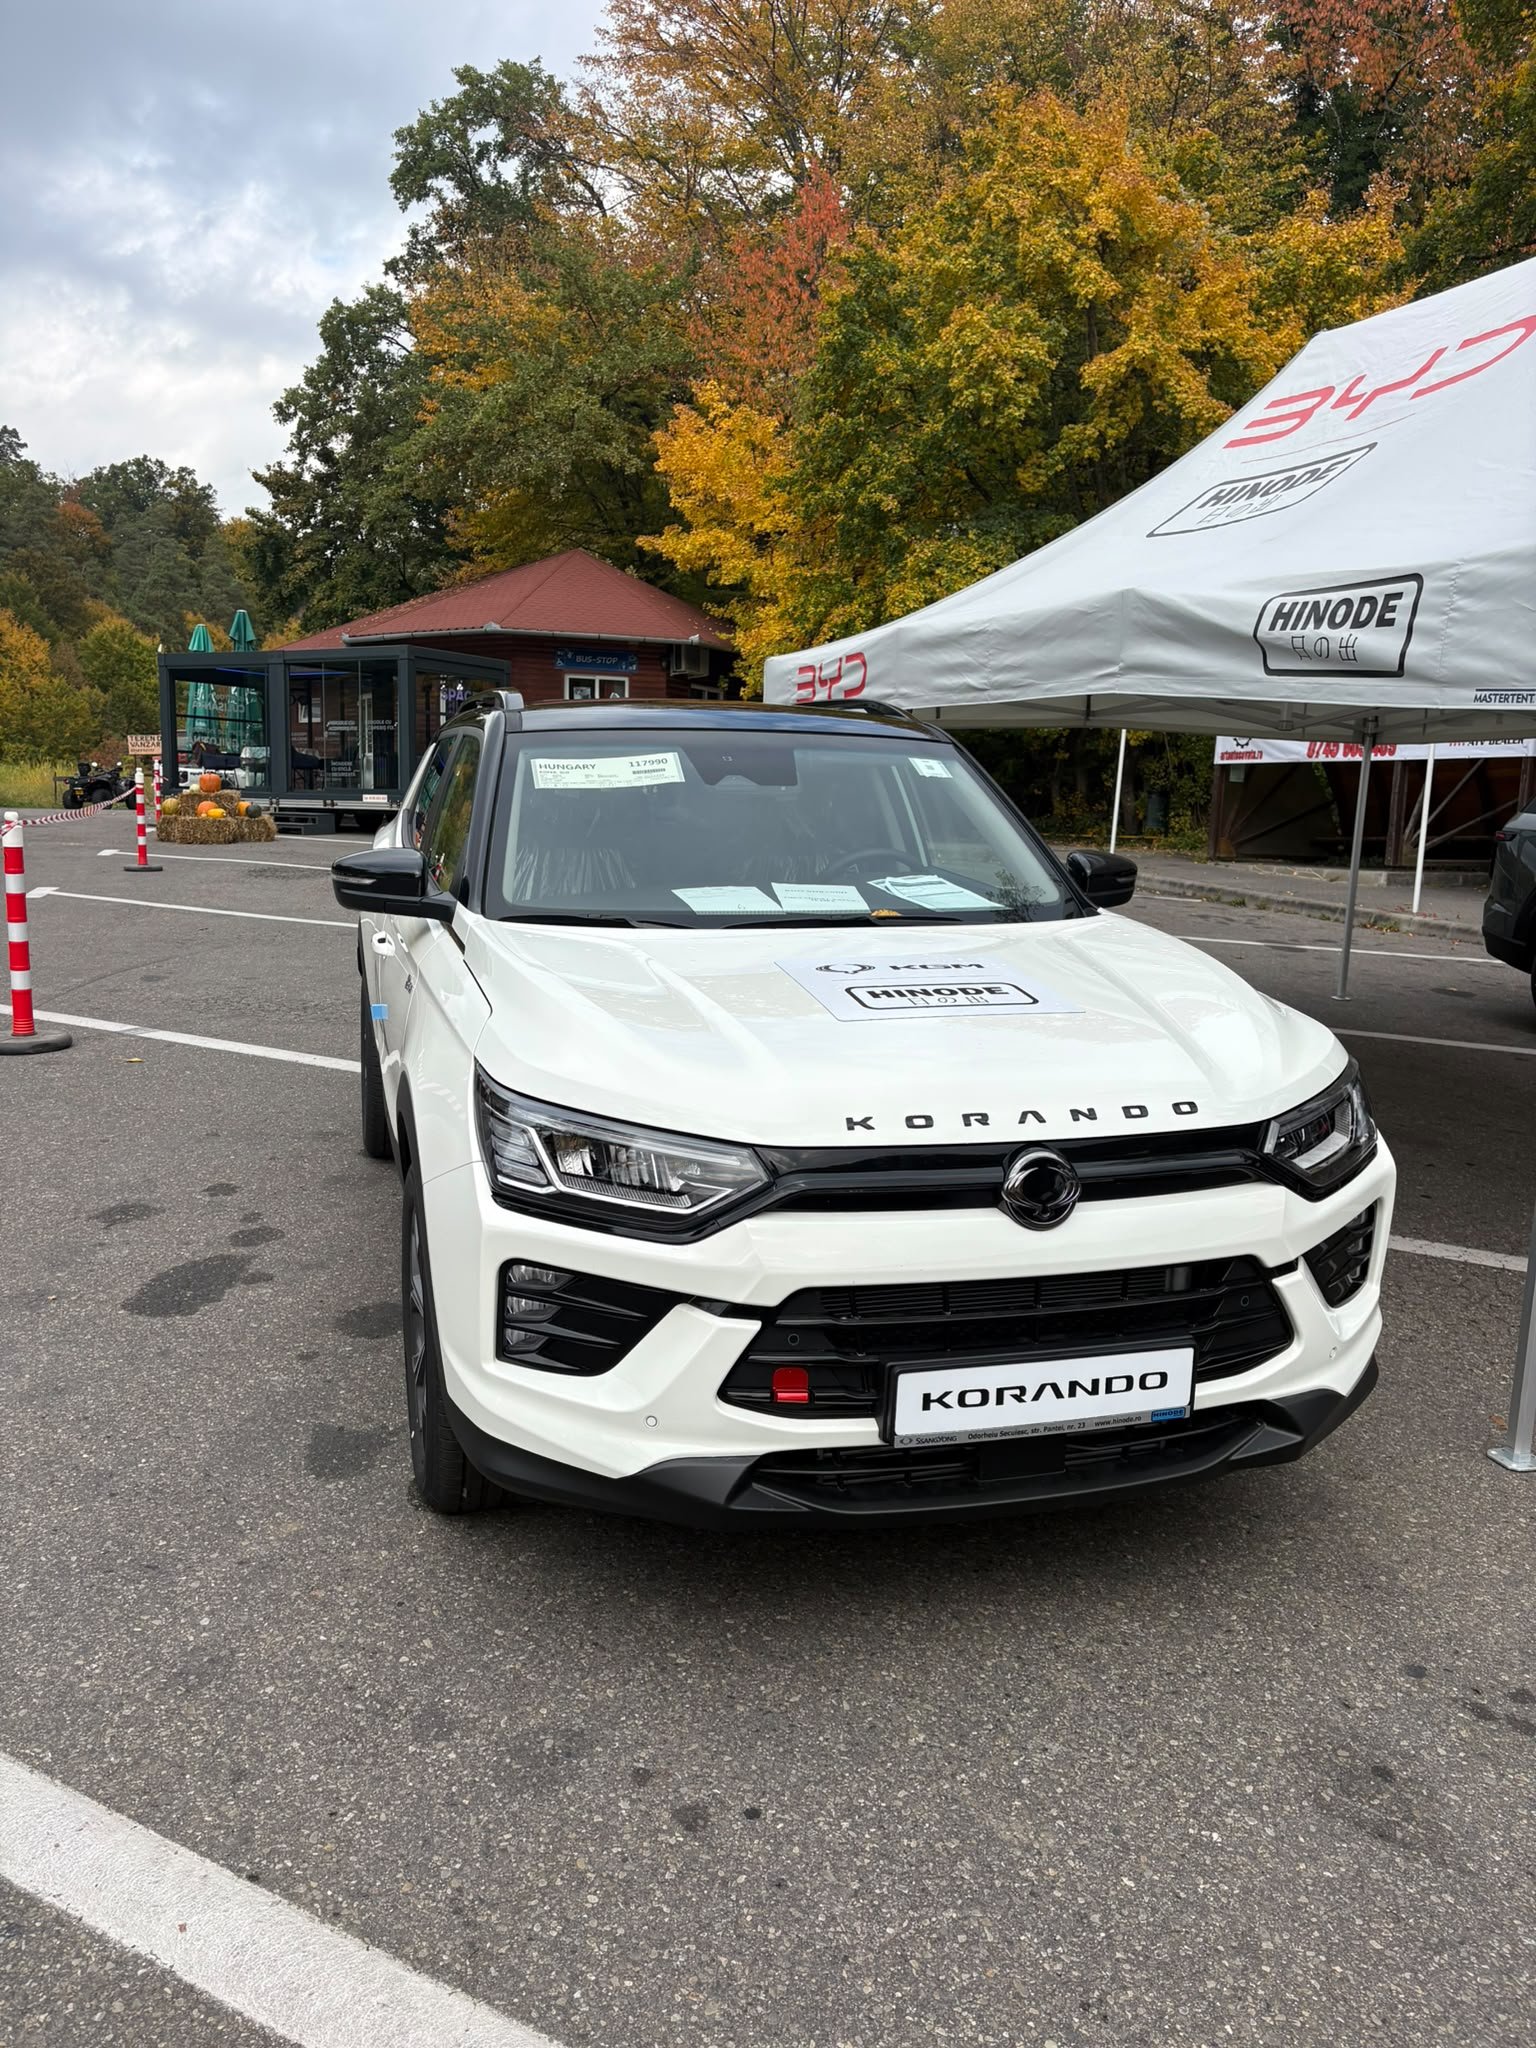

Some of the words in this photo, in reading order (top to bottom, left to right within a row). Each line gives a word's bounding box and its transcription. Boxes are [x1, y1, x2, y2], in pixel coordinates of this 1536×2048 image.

[1223, 315, 1536, 449] BYD
[1197, 458, 1351, 509] HINODE
[1268, 592, 1404, 631] HINODE
[575, 655, 619, 664] BUS-STOP
[1291, 633, 1358, 663] 日の出
[796, 652, 867, 704] BYD
[441, 688, 472, 701] SPAC
[1473, 693, 1534, 703] MASTERTENT
[629, 758, 668, 767] 117990
[889, 963, 985, 971] KGM
[865, 986, 1009, 999] HINODE
[845, 1100, 1199, 1131] KORANDO
[922, 1370, 1168, 1411] KORANDO
[1153, 1408, 1184, 1417] HINODE
[968, 1430, 998, 1440] Odorheiu
[1094, 1415, 1142, 1427] www.hinode.ro
